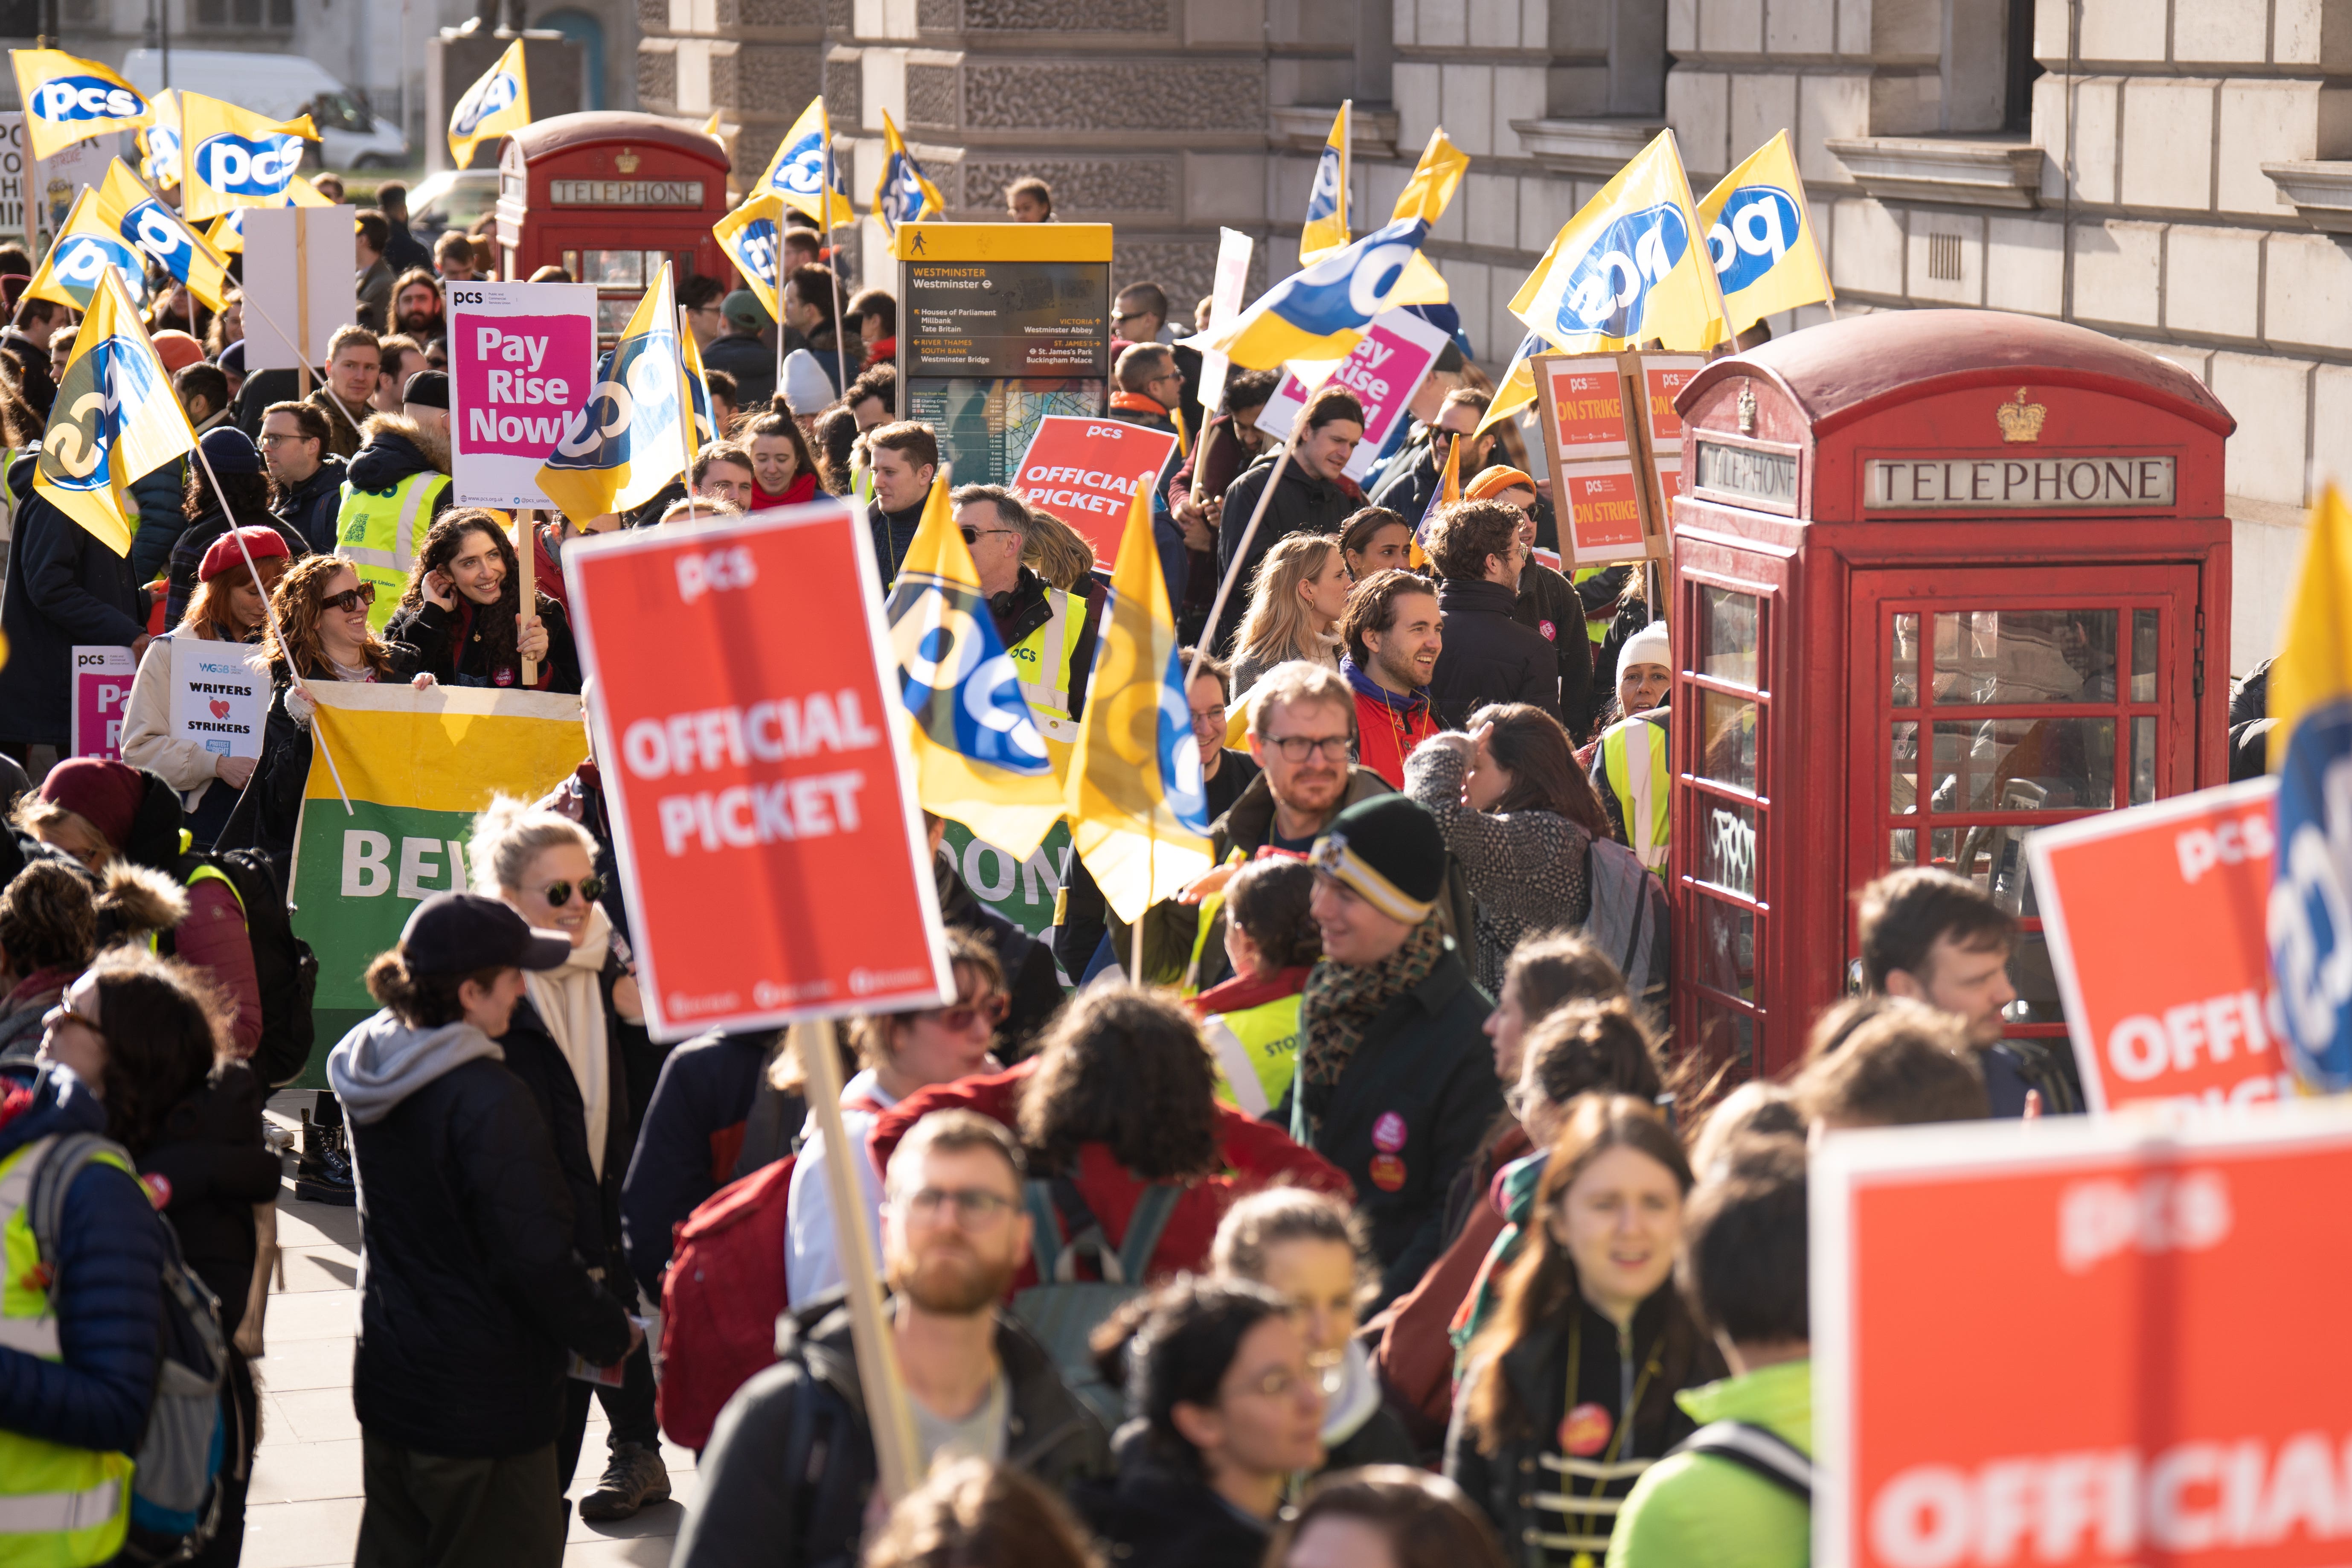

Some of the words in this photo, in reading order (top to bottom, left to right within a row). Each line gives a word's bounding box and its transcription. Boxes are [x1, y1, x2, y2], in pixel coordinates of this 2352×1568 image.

[43, 83, 136, 121] pcs
[210, 137, 303, 193] pcs
[557, 182, 698, 203] TELEPHONE
[913, 268, 986, 276] WESTMINSTER
[913, 279, 979, 288] Westminster
[454, 292, 483, 306] pcs
[477, 327, 548, 372] Pay
[1355, 336, 1395, 369] ay
[488, 369, 569, 404] Rise
[1570, 378, 1587, 393] pcs
[1663, 374, 1679, 388] pcs
[1557, 401, 1578, 421] ON
[1579, 398, 1621, 419] STRIKE
[1650, 396, 1669, 415] ON
[469, 408, 573, 443] Now!
[1086, 425, 1123, 439] pcs
[1026, 466, 1138, 497] OFFICIAL
[1585, 480, 1602, 496] pcs
[1881, 461, 2161, 501] TELEPHONE
[1027, 488, 1125, 516] PICKET
[1573, 503, 1593, 524] ON
[1594, 500, 1637, 521] STRIKE
[675, 546, 758, 602] pcs
[78, 655, 105, 667] pcs
[199, 663, 229, 673] WGGB
[189, 682, 252, 696] WRITERS
[188, 721, 250, 734] STRIKERS
[622, 689, 879, 779] OFFICIAL
[659, 773, 866, 855] PICKET
[2175, 814, 2274, 883] pcs
[1265, 1036, 1296, 1058] STO
[2057, 1169, 2233, 1271] pcs
[1869, 1429, 2352, 1568] OFFICIA
